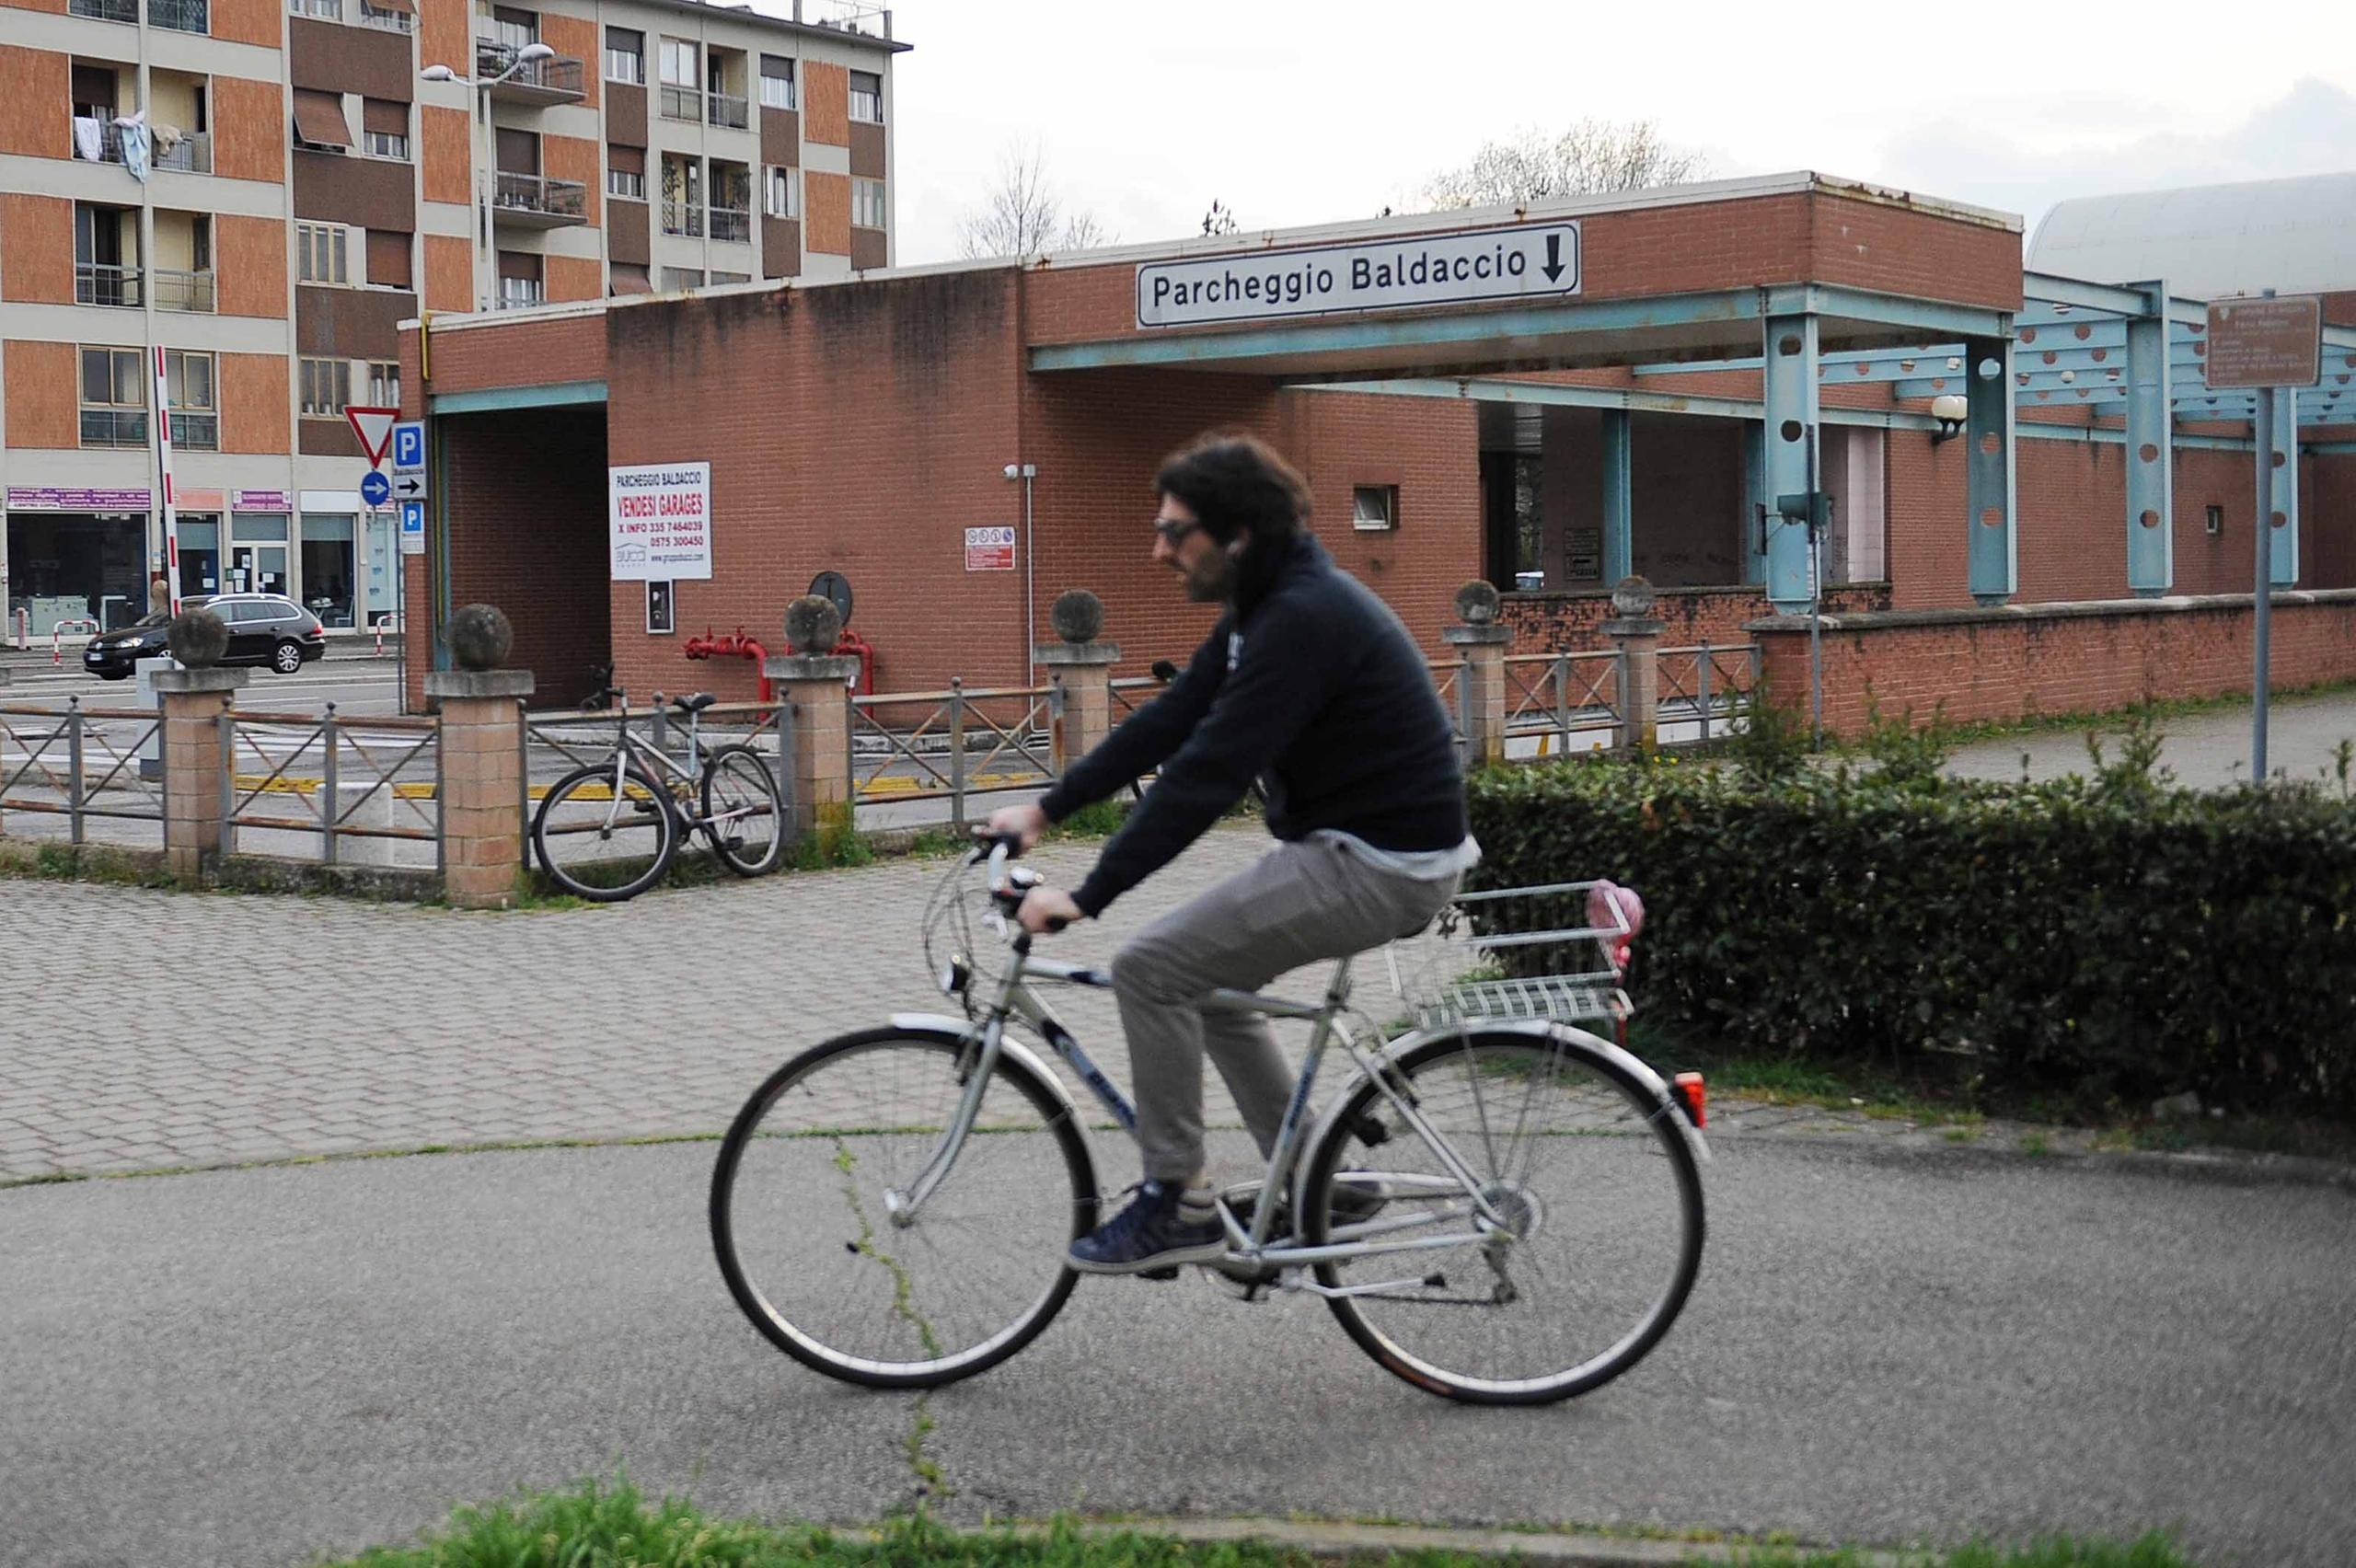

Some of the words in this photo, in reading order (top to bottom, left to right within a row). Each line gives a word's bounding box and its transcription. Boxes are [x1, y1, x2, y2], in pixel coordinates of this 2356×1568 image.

[1153, 262, 1334, 307] Parcheggio
[1351, 244, 1526, 290] Baldaccio
[400, 432, 416, 461] P
[617, 473, 660, 487] PARCHEGGIO
[662, 471, 701, 486] BALDACCIO
[618, 495, 656, 517] VENDESI
[660, 493, 702, 515] GARAGES
[407, 509, 418, 526] P
[618, 524, 624, 533] X
[627, 523, 647, 533] INFO
[649, 522, 664, 533] 335
[651, 536, 670, 547] 0575
